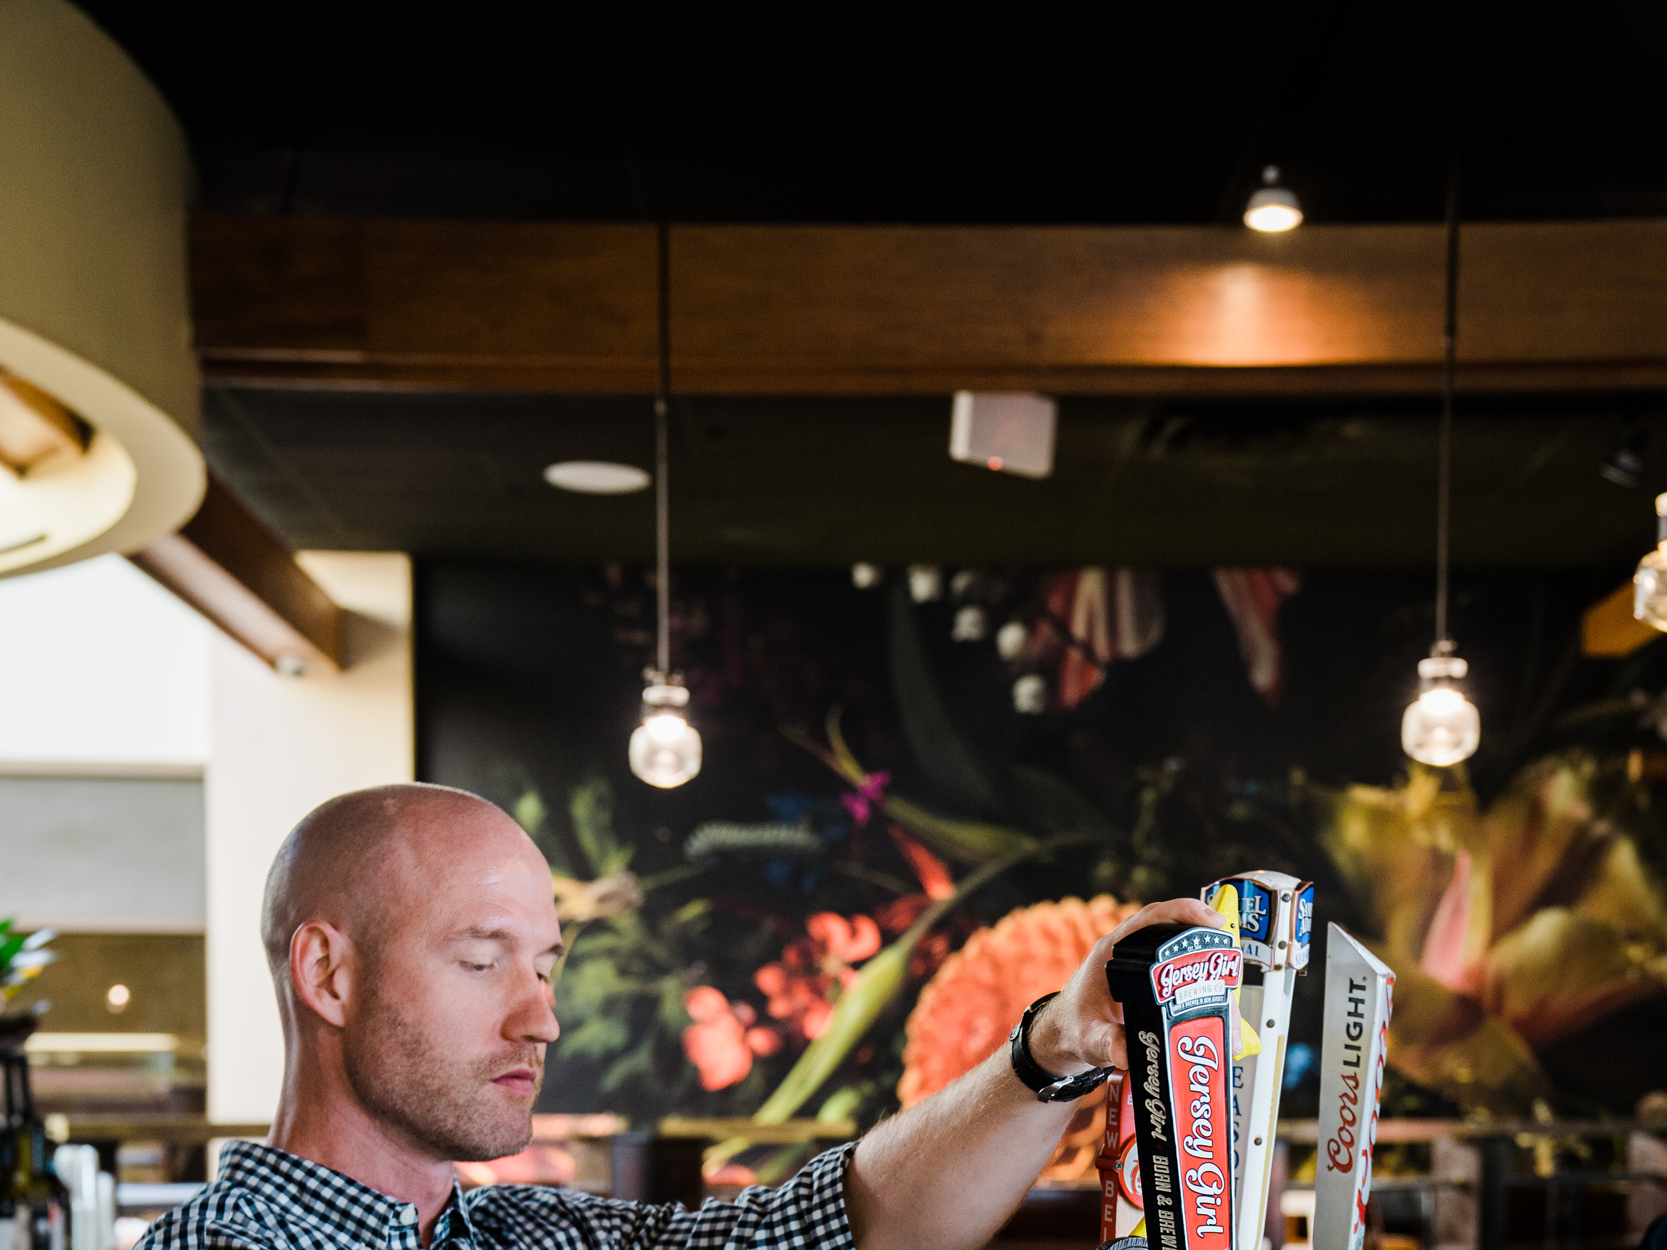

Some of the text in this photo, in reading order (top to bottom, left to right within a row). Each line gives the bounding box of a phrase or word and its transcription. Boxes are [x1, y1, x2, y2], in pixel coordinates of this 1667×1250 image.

[1160, 952, 1240, 997] Jersey Girl
[1178, 984, 1212, 1001] BREWING
[1138, 1030, 1161, 1099] Jersey
[1327, 977, 1367, 1173] Coors LIGHT
[1106, 1084, 1120, 1150] NEW
[1145, 1099, 1167, 1142] Girl
[1177, 1036, 1225, 1238] Jersey Girl
[1153, 1154, 1171, 1193] BORN
[1156, 1194, 1173, 1206] &
